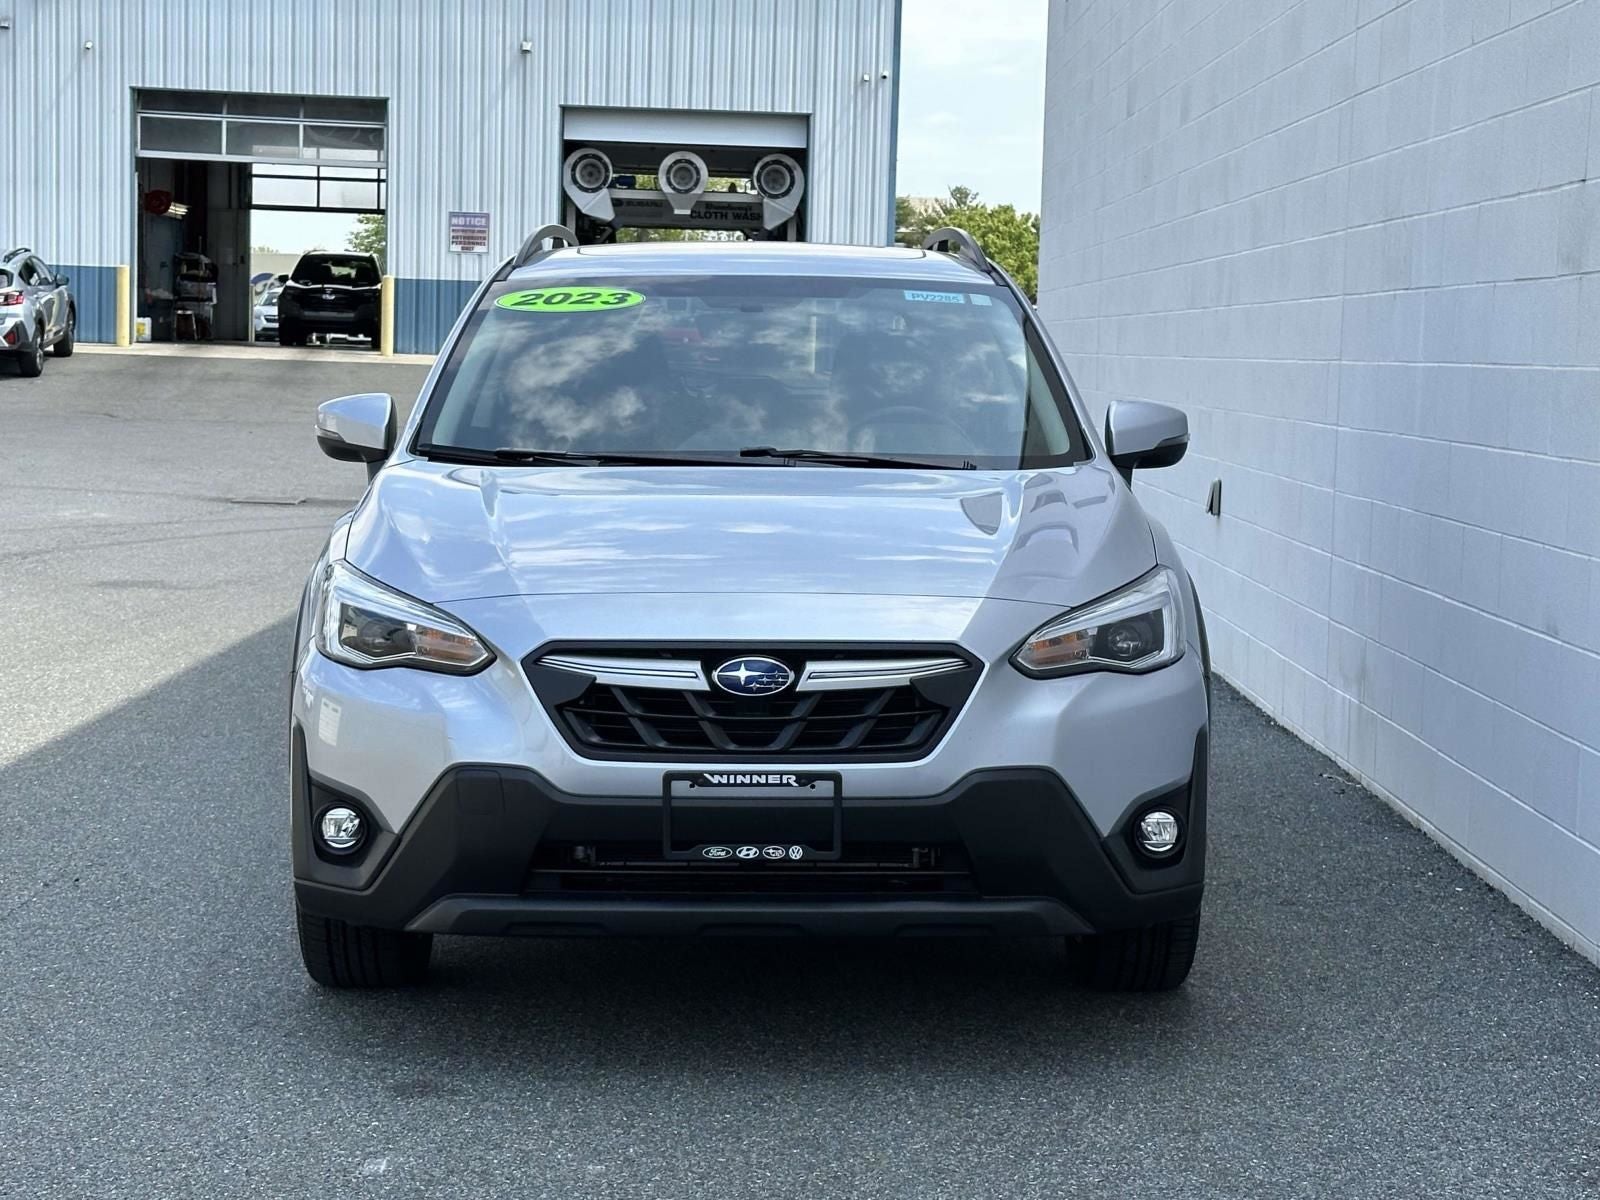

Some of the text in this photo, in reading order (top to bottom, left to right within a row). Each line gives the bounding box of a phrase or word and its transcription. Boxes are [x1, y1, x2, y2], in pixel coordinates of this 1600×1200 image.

[690, 209, 728, 220] CLOTH
[451, 216, 487, 226] NOTICE
[510, 292, 633, 306] 2023
[703, 773, 800, 787] WINNER
